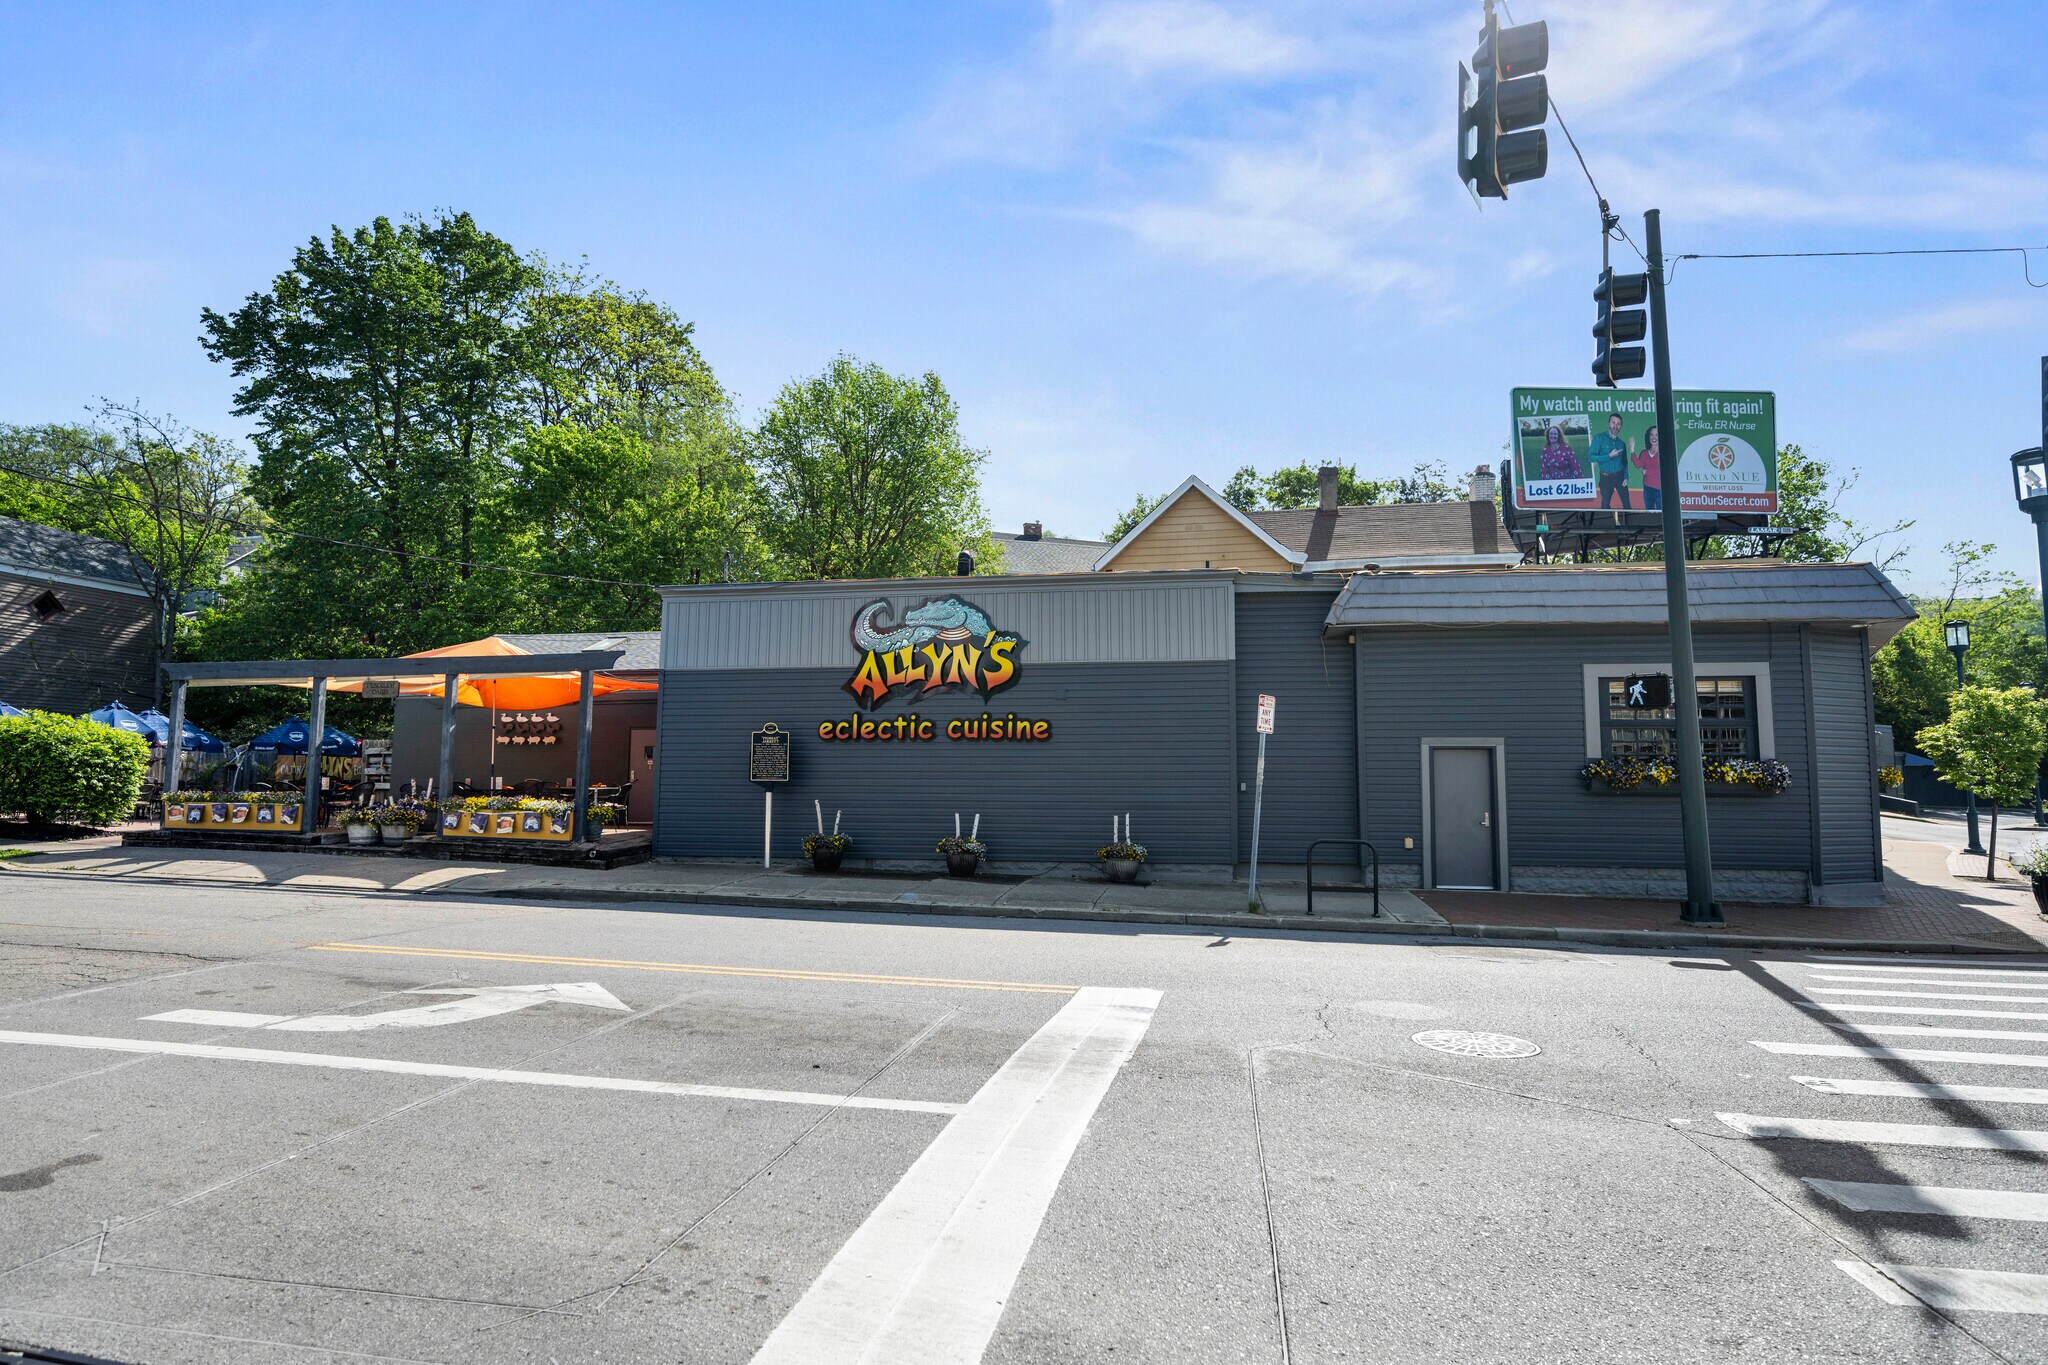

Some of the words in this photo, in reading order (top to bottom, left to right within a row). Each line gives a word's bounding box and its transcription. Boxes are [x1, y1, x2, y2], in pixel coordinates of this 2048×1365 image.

[1520, 395, 1539, 415] My
[1543, 395, 1583, 412] watch
[1587, 396, 1612, 413] and
[1616, 396, 1655, 413] weddi
[1676, 398, 1702, 418] ring
[1706, 398, 1720, 414] fit
[1723, 399, 1763, 419] again!
[1714, 420, 1727, 430] ER
[1729, 420, 1756, 431] Nurse
[1732, 471, 1760, 482] NUE
[1529, 484, 1554, 497] Lost
[1680, 494, 1769, 507] earnOurSecret.com
[851, 630, 1016, 702] ALLYN'S
[818, 713, 933, 740] eclectic
[947, 713, 1050, 740] cuisine
[1261, 717, 1271, 726] TIME
